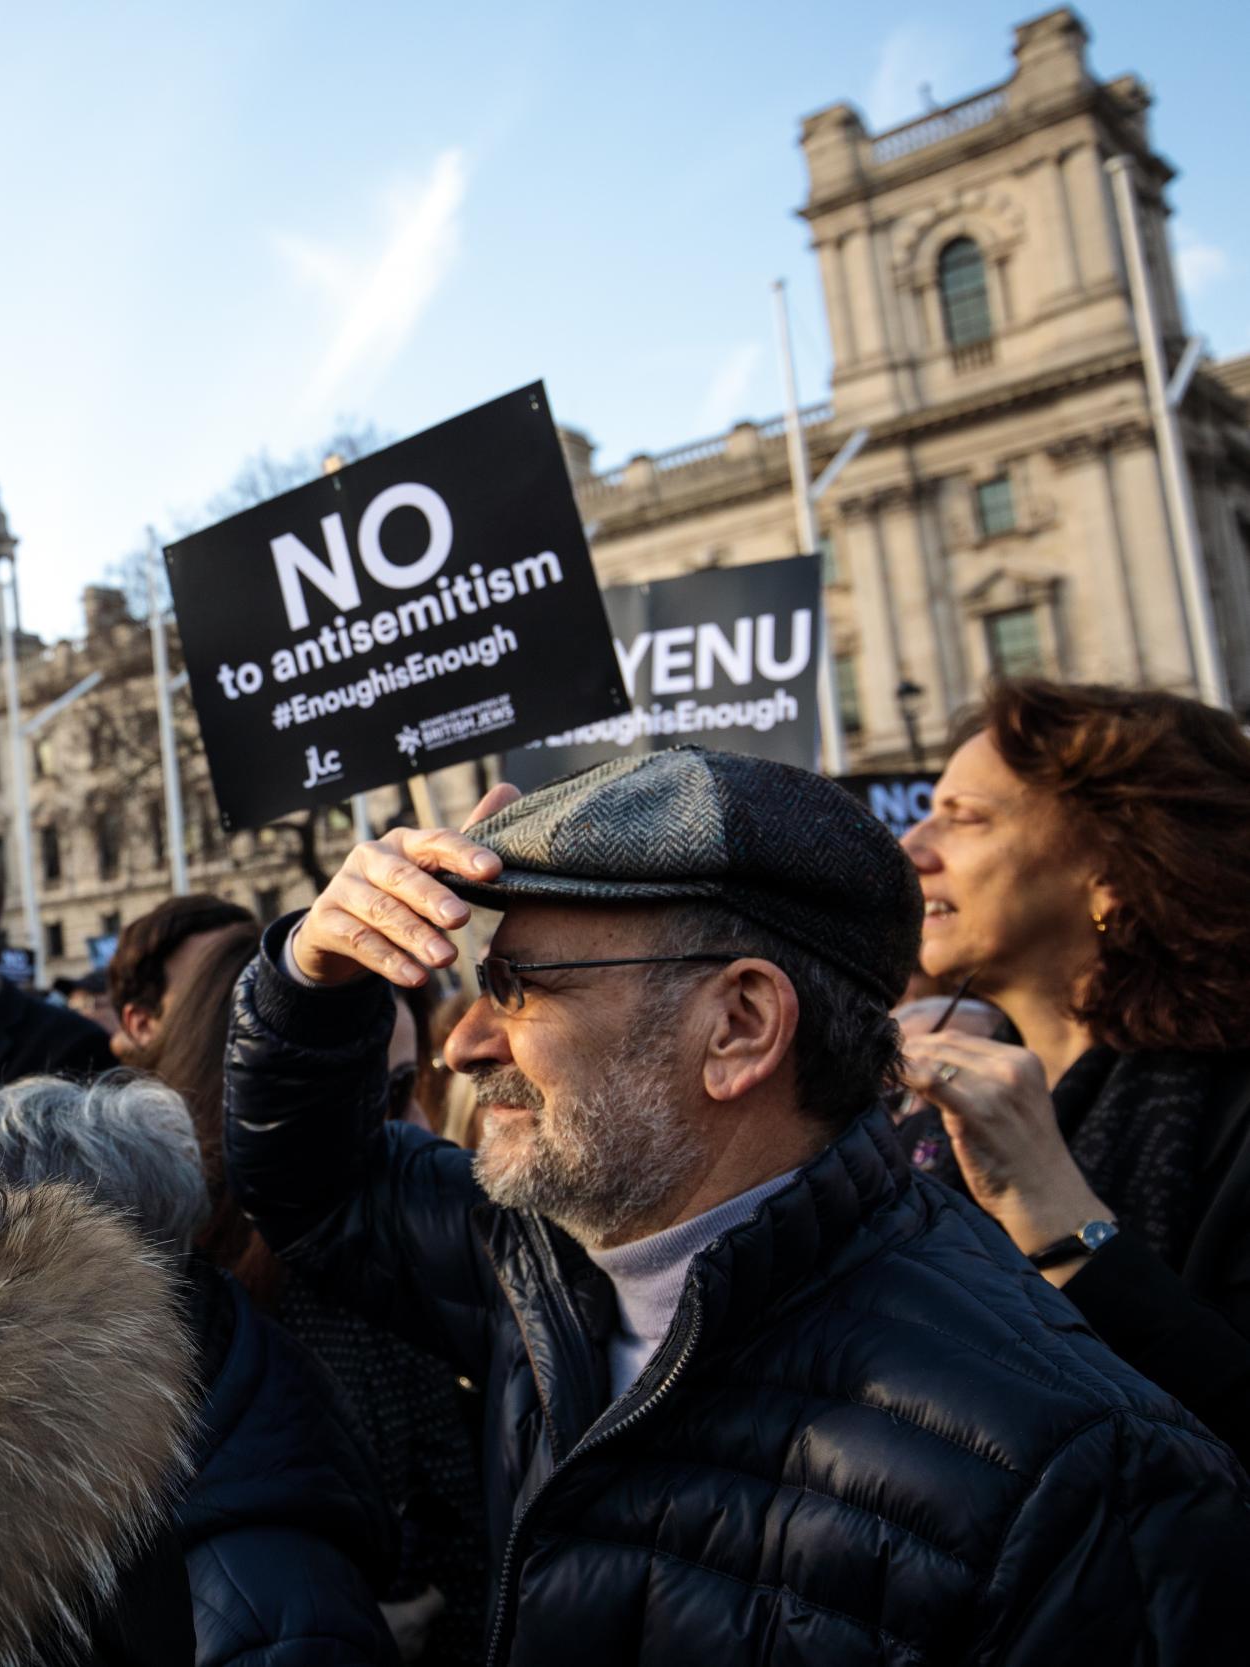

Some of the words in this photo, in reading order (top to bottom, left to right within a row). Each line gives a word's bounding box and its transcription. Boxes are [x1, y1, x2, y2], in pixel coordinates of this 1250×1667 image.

[270, 482, 453, 631] NO
[216, 663, 263, 700] to
[271, 550, 563, 683] antisemitism
[272, 624, 518, 730] #EnoughisEnough
[612, 608, 812, 700] YENU
[868, 780, 934, 824] NO
